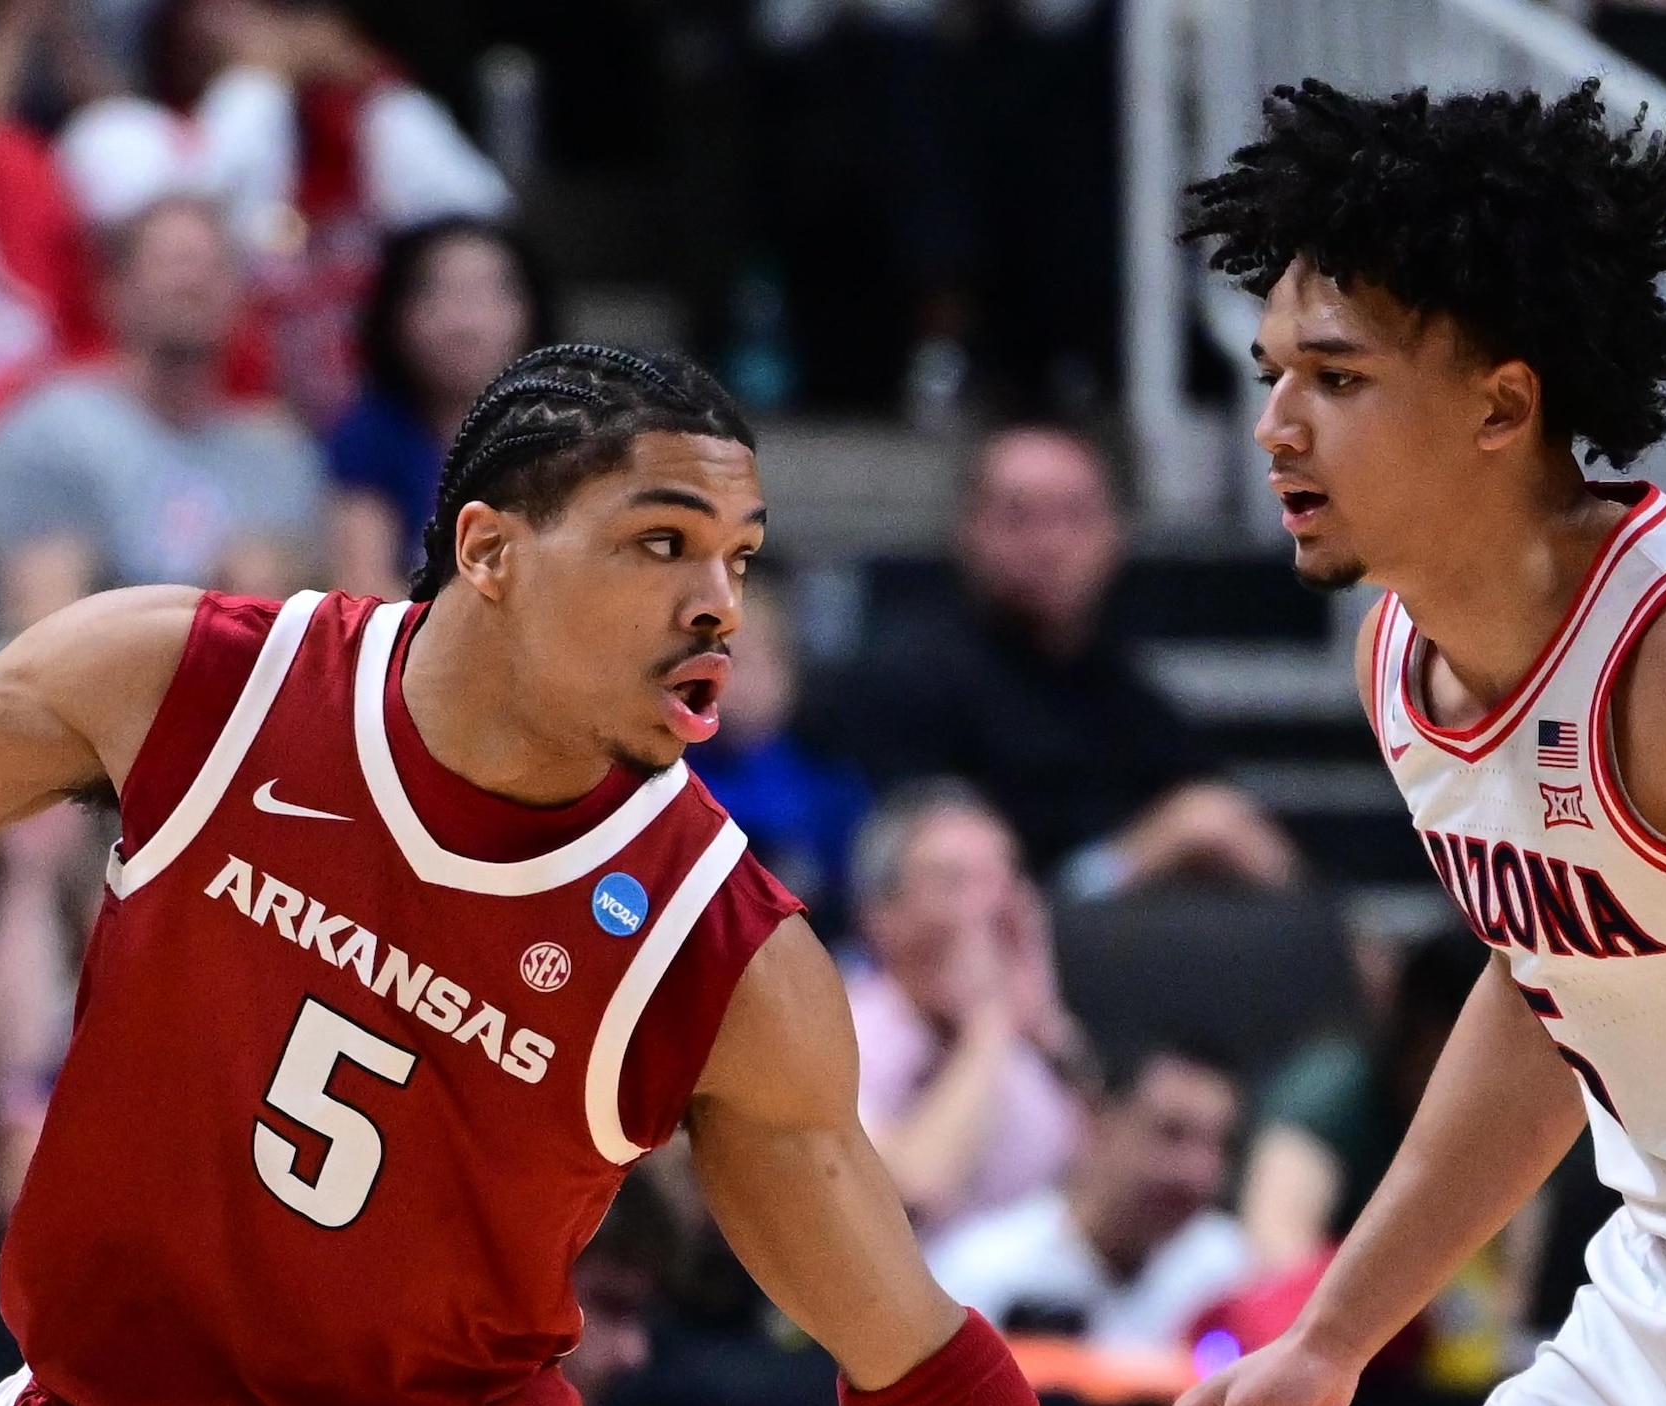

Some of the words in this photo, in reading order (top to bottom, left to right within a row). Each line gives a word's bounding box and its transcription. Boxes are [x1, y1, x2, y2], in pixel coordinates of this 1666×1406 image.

[203, 853, 557, 1084] ARKANSAS
[524, 946, 567, 988] SEC
[596, 891, 640, 931] NCAA
[251, 994, 420, 1229] 5
